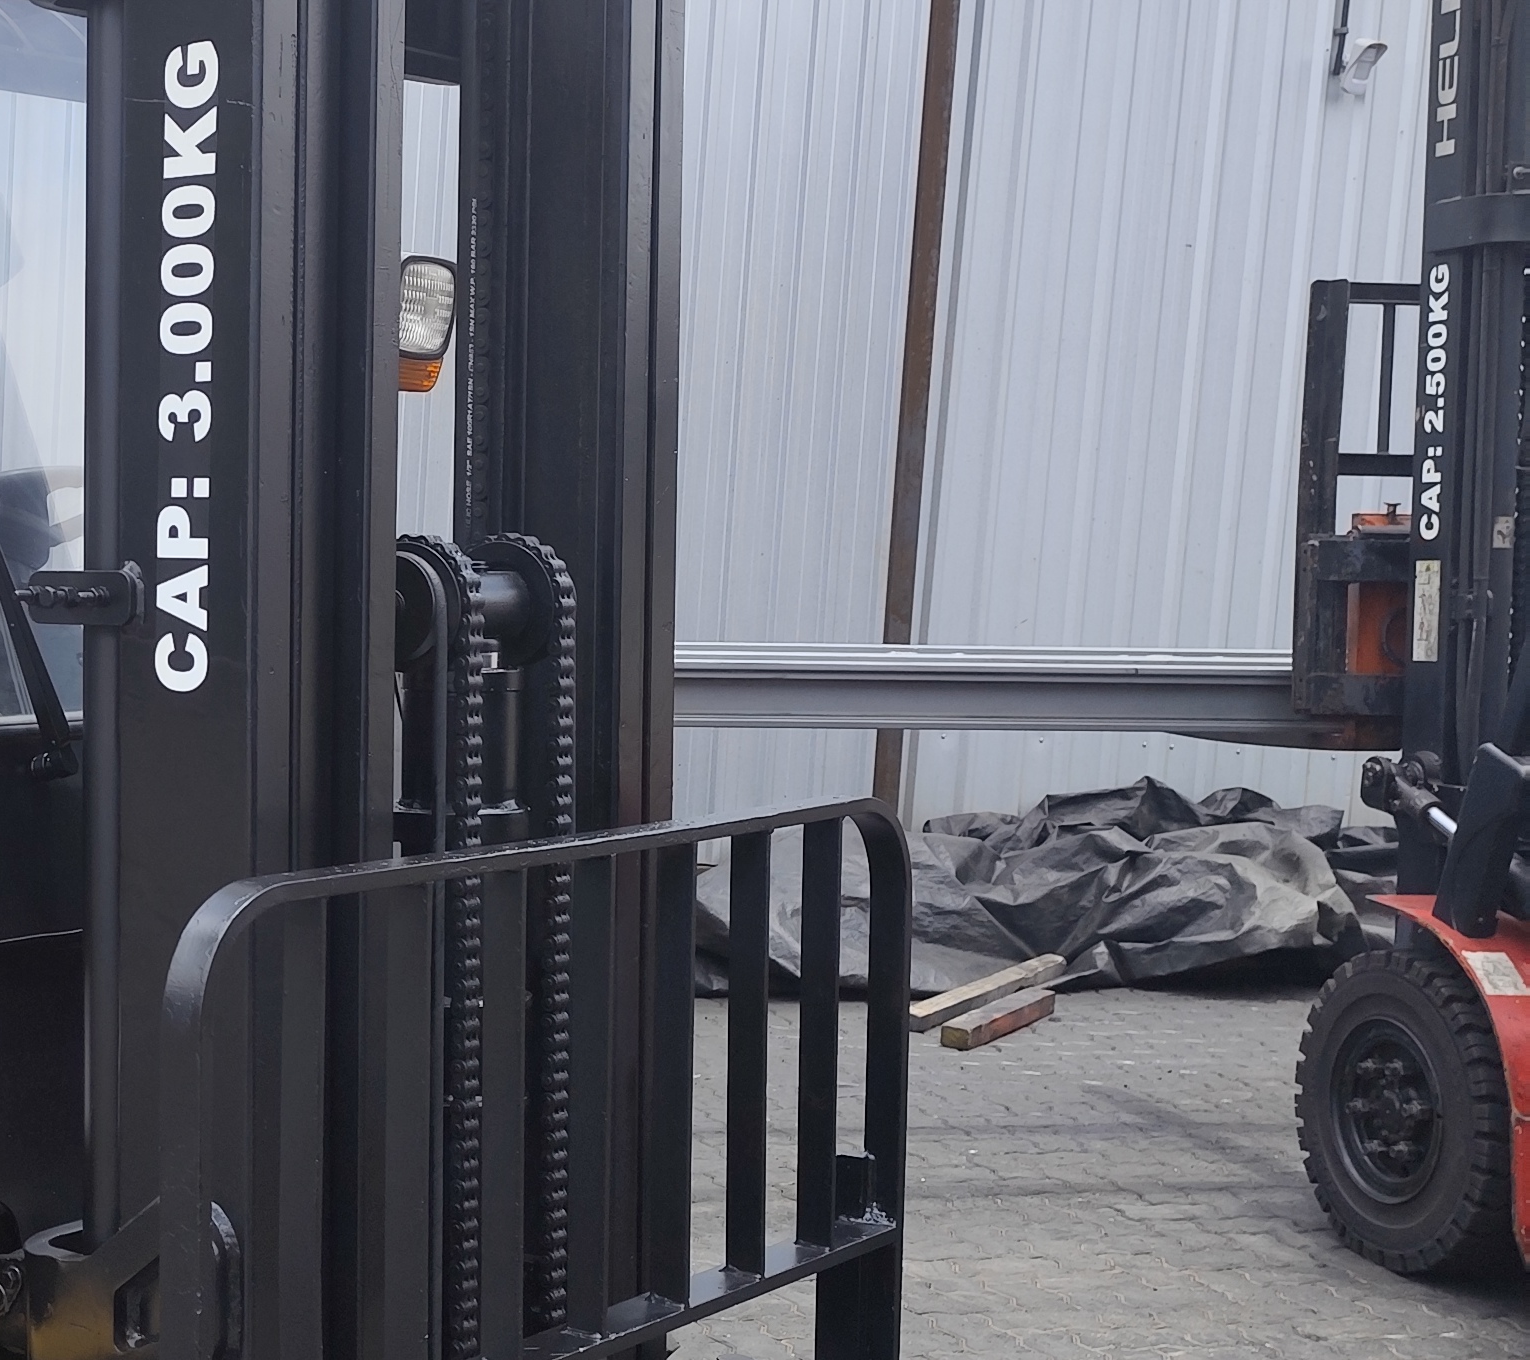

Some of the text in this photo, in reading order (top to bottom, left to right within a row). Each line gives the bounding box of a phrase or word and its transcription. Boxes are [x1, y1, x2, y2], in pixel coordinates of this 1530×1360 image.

[155, 40, 219, 692] CAP: 3.000KG
[1422, 262, 1452, 436] 2.500KG
[1419, 446, 1444, 542] CAP:
